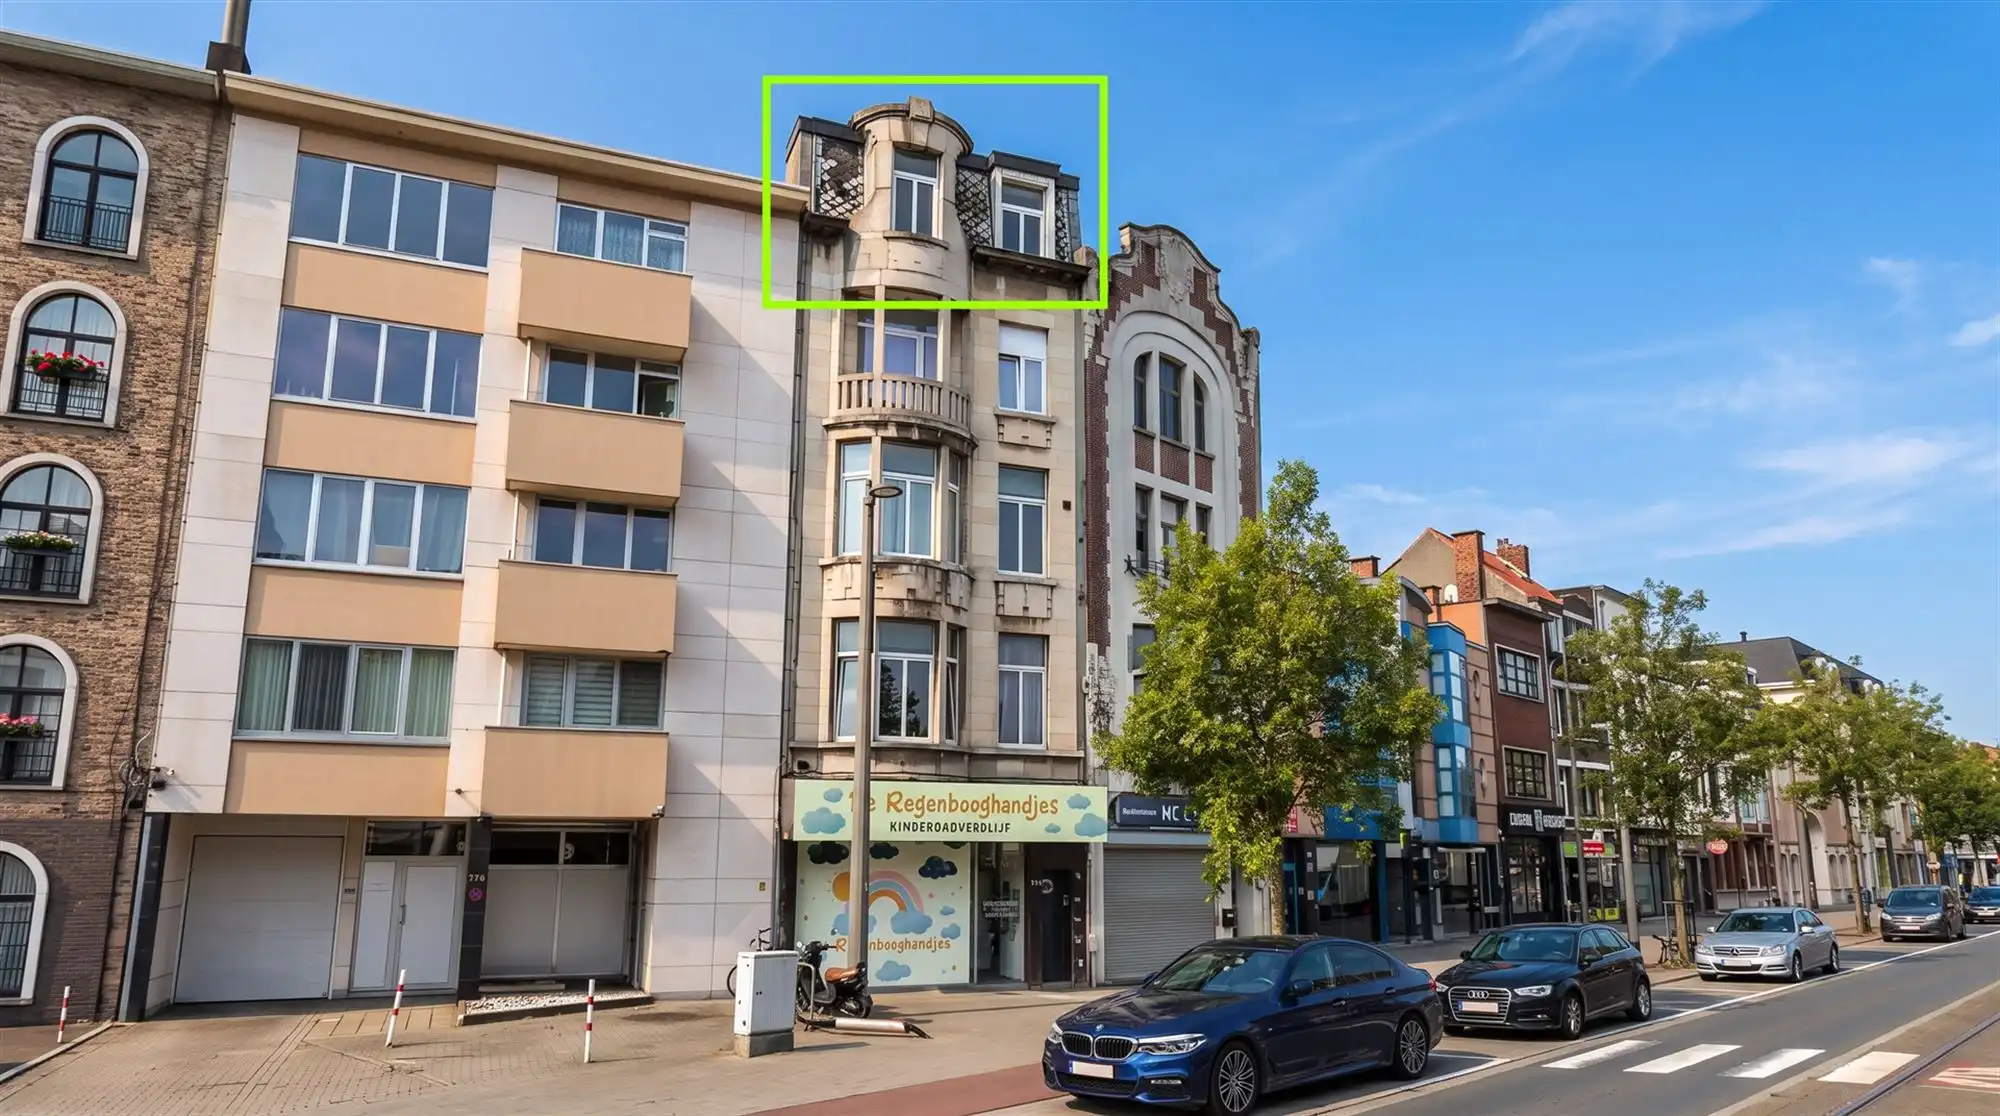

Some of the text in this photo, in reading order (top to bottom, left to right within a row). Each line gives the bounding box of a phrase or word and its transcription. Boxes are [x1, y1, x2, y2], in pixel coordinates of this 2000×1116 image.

[886, 790, 1059, 820] Regenbooghandjes
[1162, 805, 1180, 821] NC
[889, 821, 1010, 833] KINDEROADVERDLIJF
[836, 936, 950, 953] Rnbooghandjes
